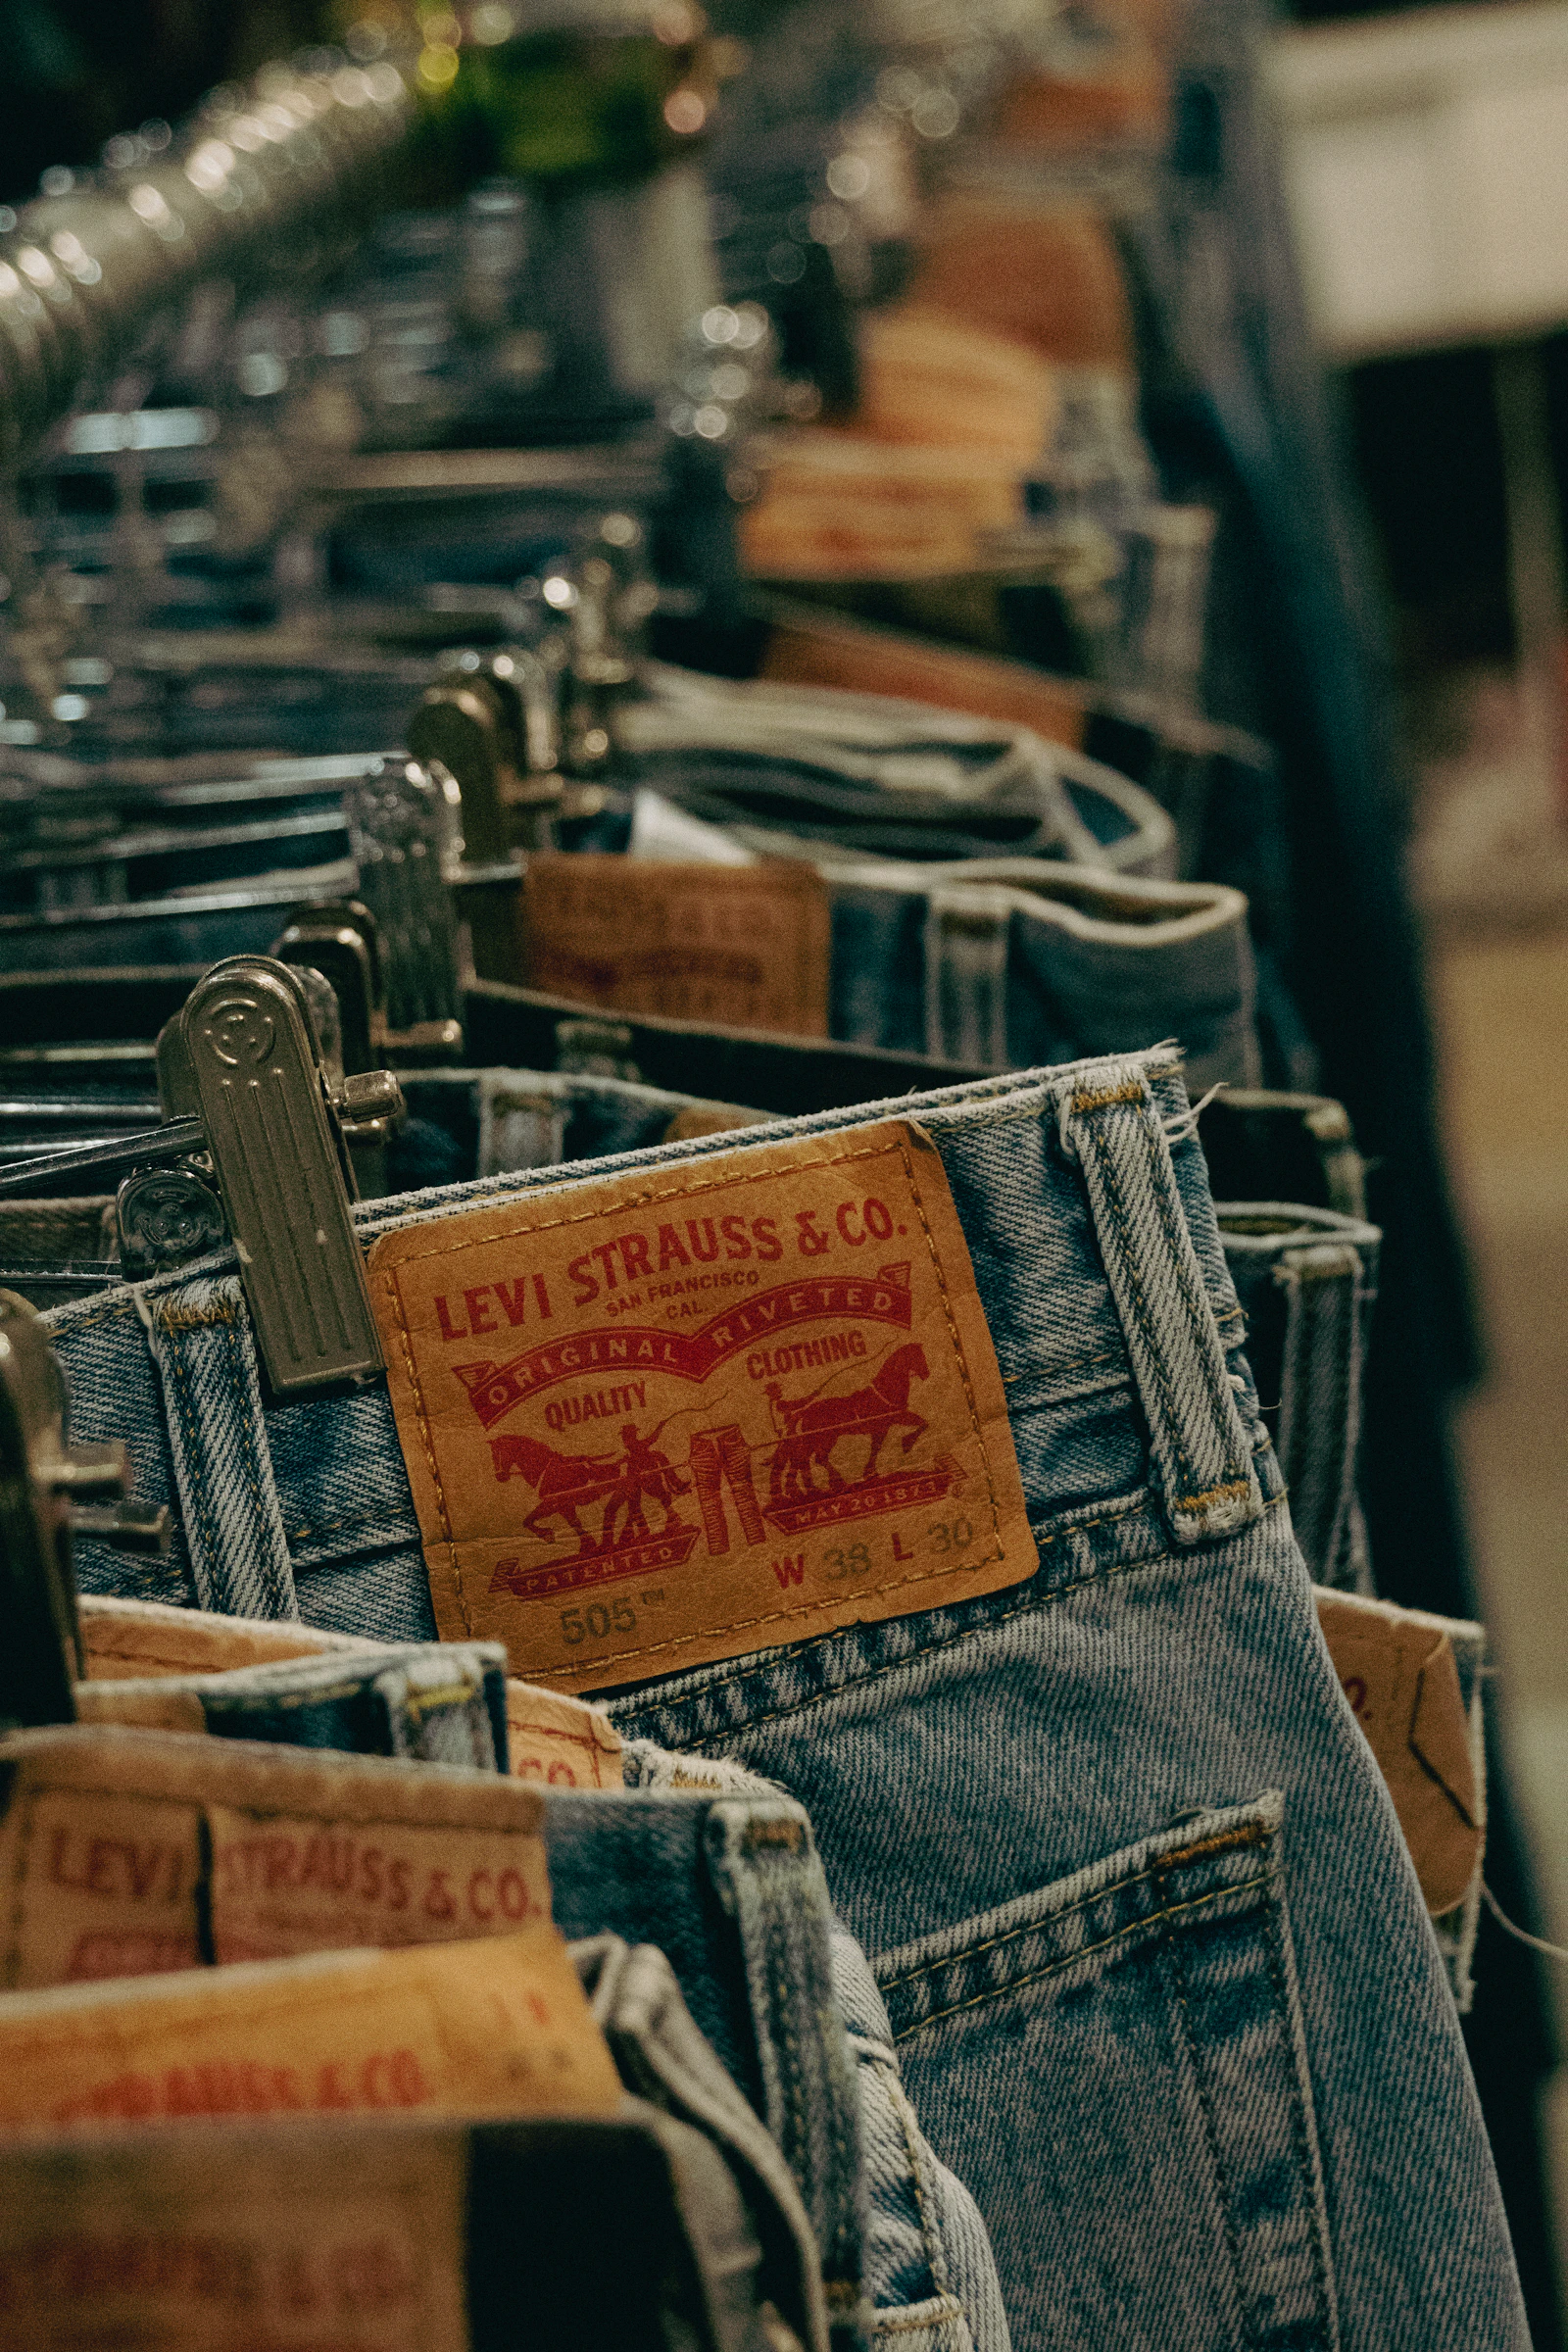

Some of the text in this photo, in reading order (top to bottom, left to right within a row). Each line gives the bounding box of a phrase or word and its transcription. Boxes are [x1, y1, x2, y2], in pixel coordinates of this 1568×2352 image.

[433, 1198, 907, 1341] LEVI STRAUSS & CO.
[606, 1270, 760, 1318] SAN FRANCISCO
[490, 1287, 892, 1405] ORIGINAL RIVETED
[665, 1299, 709, 1320] CAL.
[544, 1330, 867, 1431] QUALITY CLOTHING
[795, 1503, 841, 1526] MAY
[851, 1494, 876, 1511] 20
[884, 1481, 937, 1503] 1873
[526, 1546, 673, 1591] PATENTED
[771, 1516, 973, 1589] W 38 L 30
[48, 1827, 185, 1904] LEVI
[422, 1871, 460, 1921] &
[466, 1867, 542, 1921] CO.
